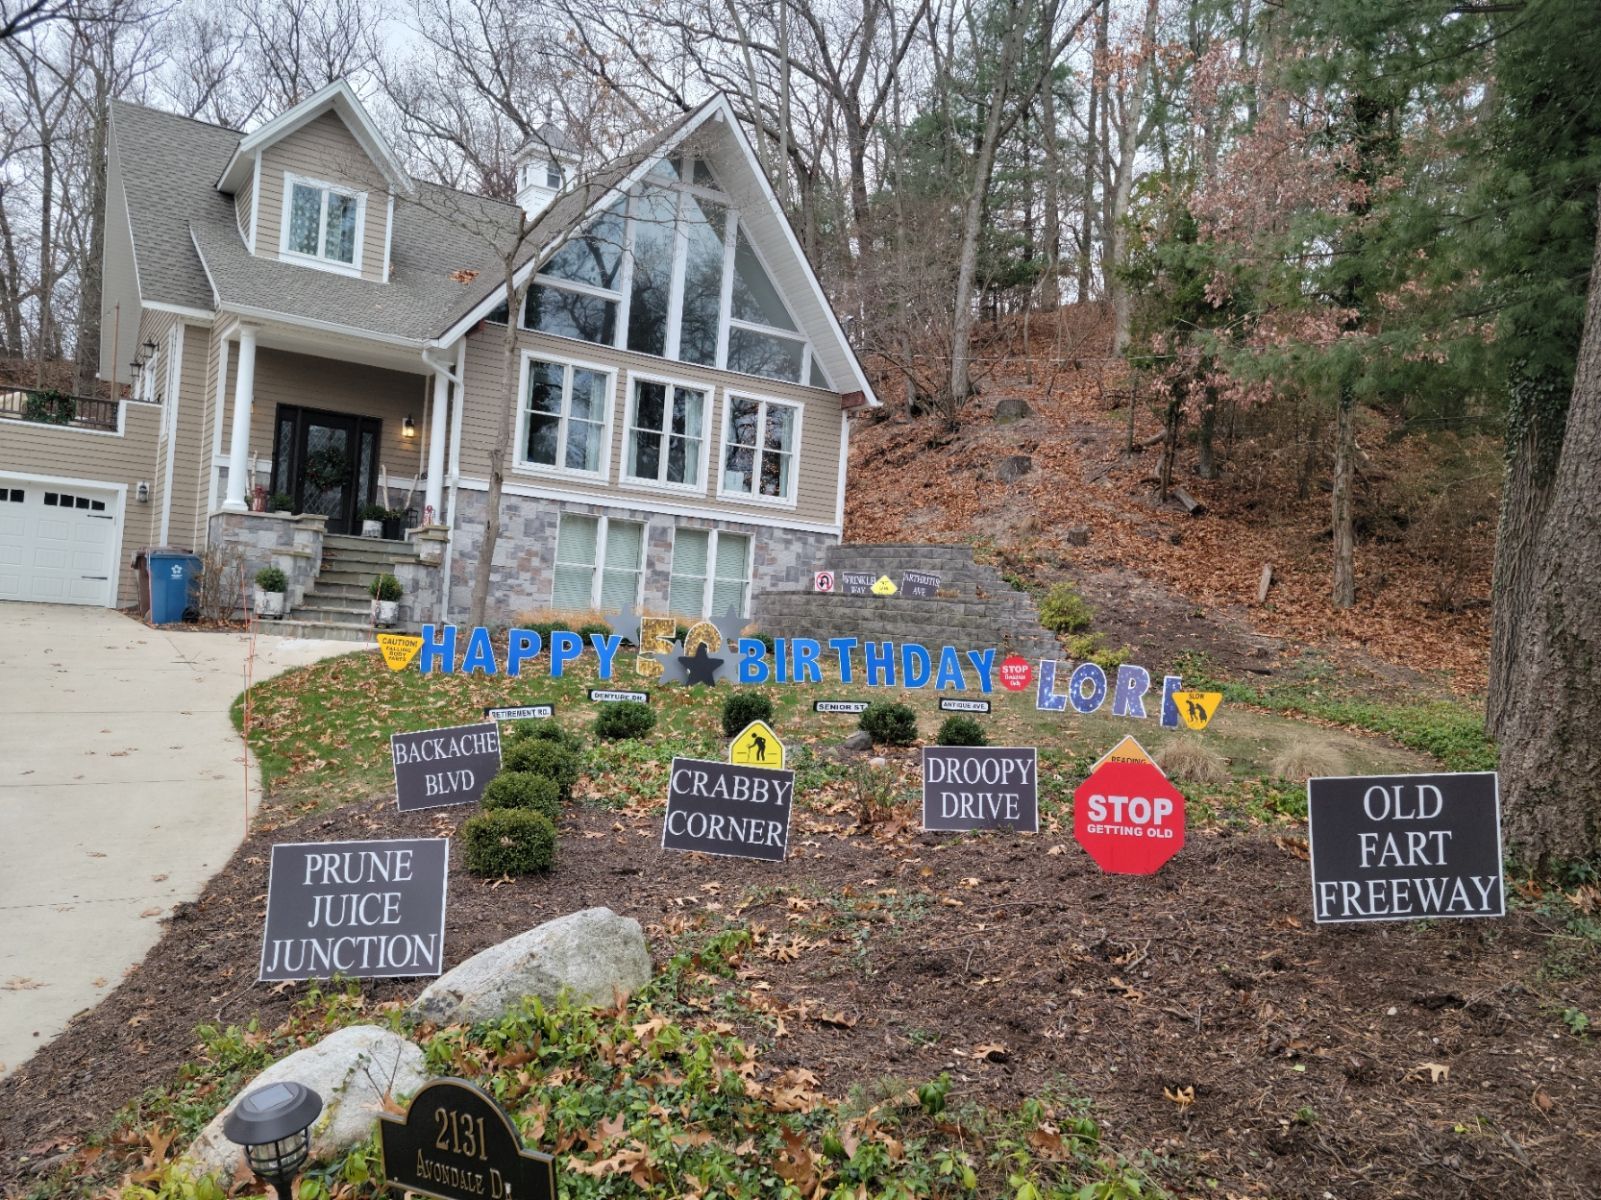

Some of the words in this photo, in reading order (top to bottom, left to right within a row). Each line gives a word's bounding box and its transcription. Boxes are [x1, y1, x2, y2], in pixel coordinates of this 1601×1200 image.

[912, 588, 926, 597] AVE
[382, 637, 418, 647] CAUTION!
[419, 624, 623, 680] HAPPY
[738, 637, 997, 693] BIRTHDAY
[1002, 665, 1029, 674] STOP
[818, 703, 852, 711] SENIOR
[943, 701, 972, 709] ANTIQUE
[1036, 659, 1182, 728] LORI
[492, 709, 537, 719] RETIREMENT
[394, 731, 499, 765] BACKACHE
[425, 769, 475, 797] BLVD
[671, 768, 792, 806] CRABBY
[927, 757, 1033, 785] DROOPY
[940, 791, 1021, 820] DRIVE
[1087, 794, 1173, 825] STOP
[1363, 784, 1443, 821] OLD
[667, 809, 785, 847] CORNER
[1087, 823, 1143, 838] GETTING
[1146, 826, 1173, 839] OLD
[1357, 831, 1452, 868] FART
[302, 850, 413, 885] PRUNE
[307, 892, 402, 928] JUICE
[1317, 876, 1498, 917] FREEWAY
[266, 933, 438, 973] JUNCTION
[434, 1107, 489, 1161] 2131
